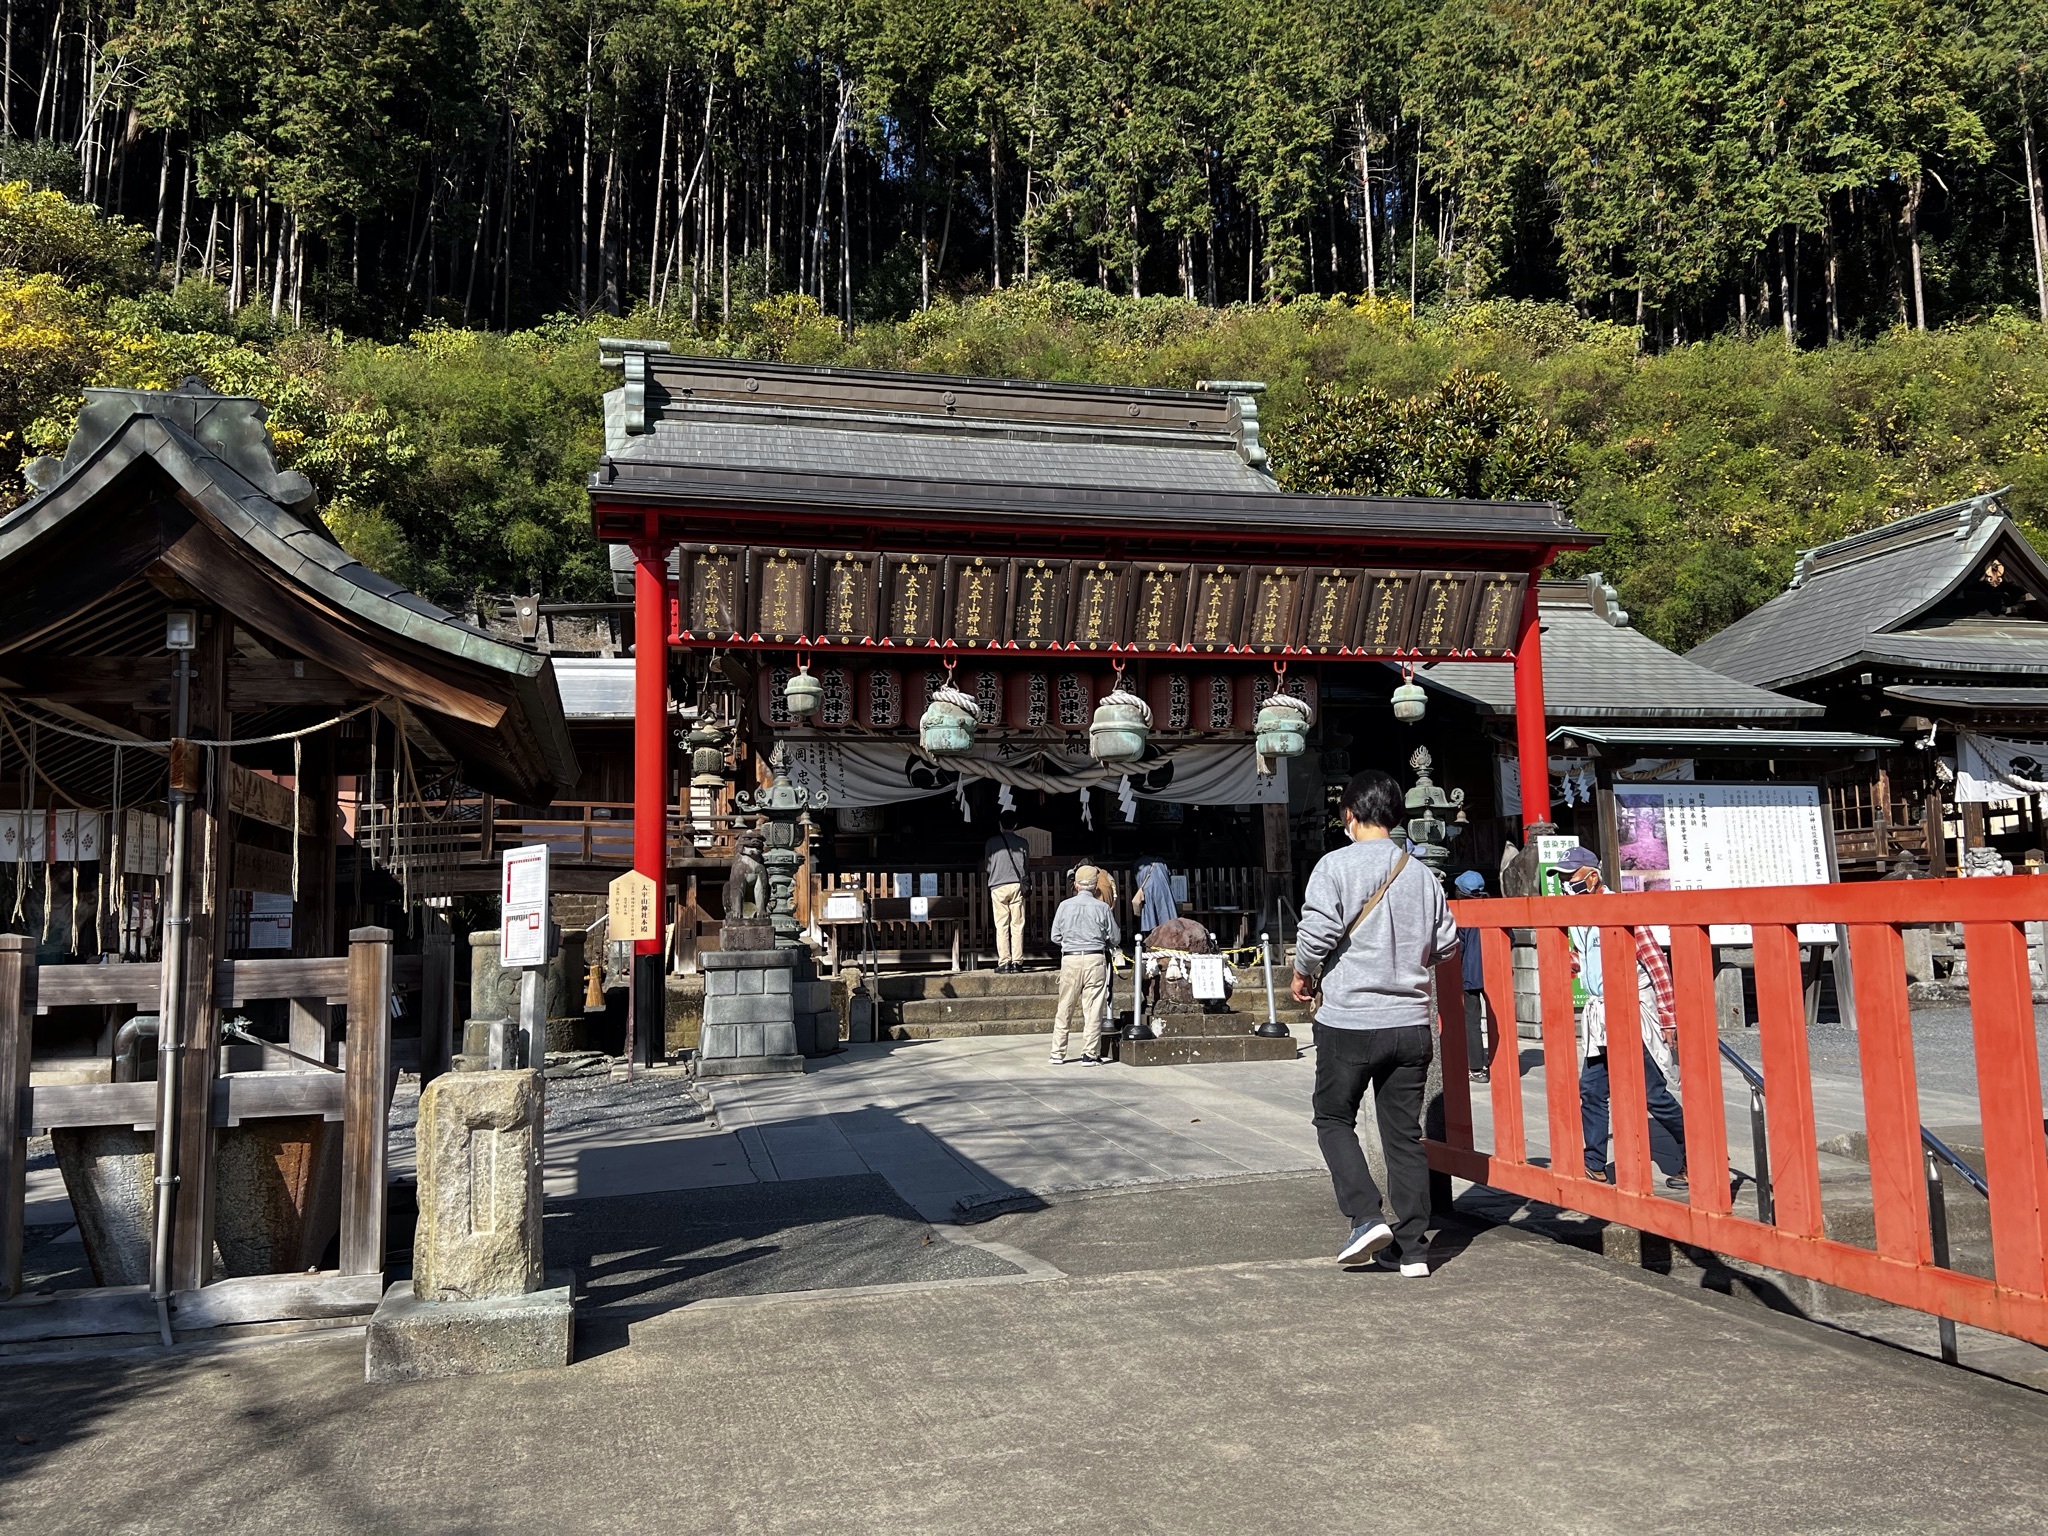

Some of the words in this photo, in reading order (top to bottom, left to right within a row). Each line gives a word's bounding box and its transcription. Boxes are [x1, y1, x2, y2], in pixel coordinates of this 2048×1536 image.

[697, 554, 729, 566] 奉納
[766, 557, 798, 570] 奉納
[833, 561, 864, 573] 奉納
[898, 563, 929, 575] 奉納
[962, 565, 992, 578] 奉納
[1025, 567, 1054, 579] 奉納
[1086, 570, 1114, 582] 奉納
[1145, 571, 1174, 583] 奉納
[1204, 573, 1232, 585] 奉納
[1262, 574, 1290, 586] 奉納
[1320, 576, 1347, 588] 奉納
[1376, 578, 1404, 589] 奉納
[1432, 579, 1458, 590] 奉納
[1486, 581, 1512, 592] 奉納
[704, 566, 720, 628] 太平山神社
[772, 570, 789, 631] 太平山神社
[838, 572, 856, 633] 太平山神社
[902, 574, 920, 635] 太平山神社
[966, 577, 984, 636] 太平山神社
[1027, 579, 1045, 638] 太平山神社
[1086, 581, 1106, 640] 太平山神社
[1146, 582, 1164, 641] 太平山神社
[1204, 584, 1224, 642] 太平山神社
[1260, 586, 1282, 643] 太平山神社
[1318, 587, 1338, 644] 太平山神社
[1374, 588, 1394, 644] 太平山神社
[1428, 590, 1449, 646] 太平山神社
[1482, 592, 1504, 647] 太平山神社
[1543, 840, 1576, 848] 感染予防
